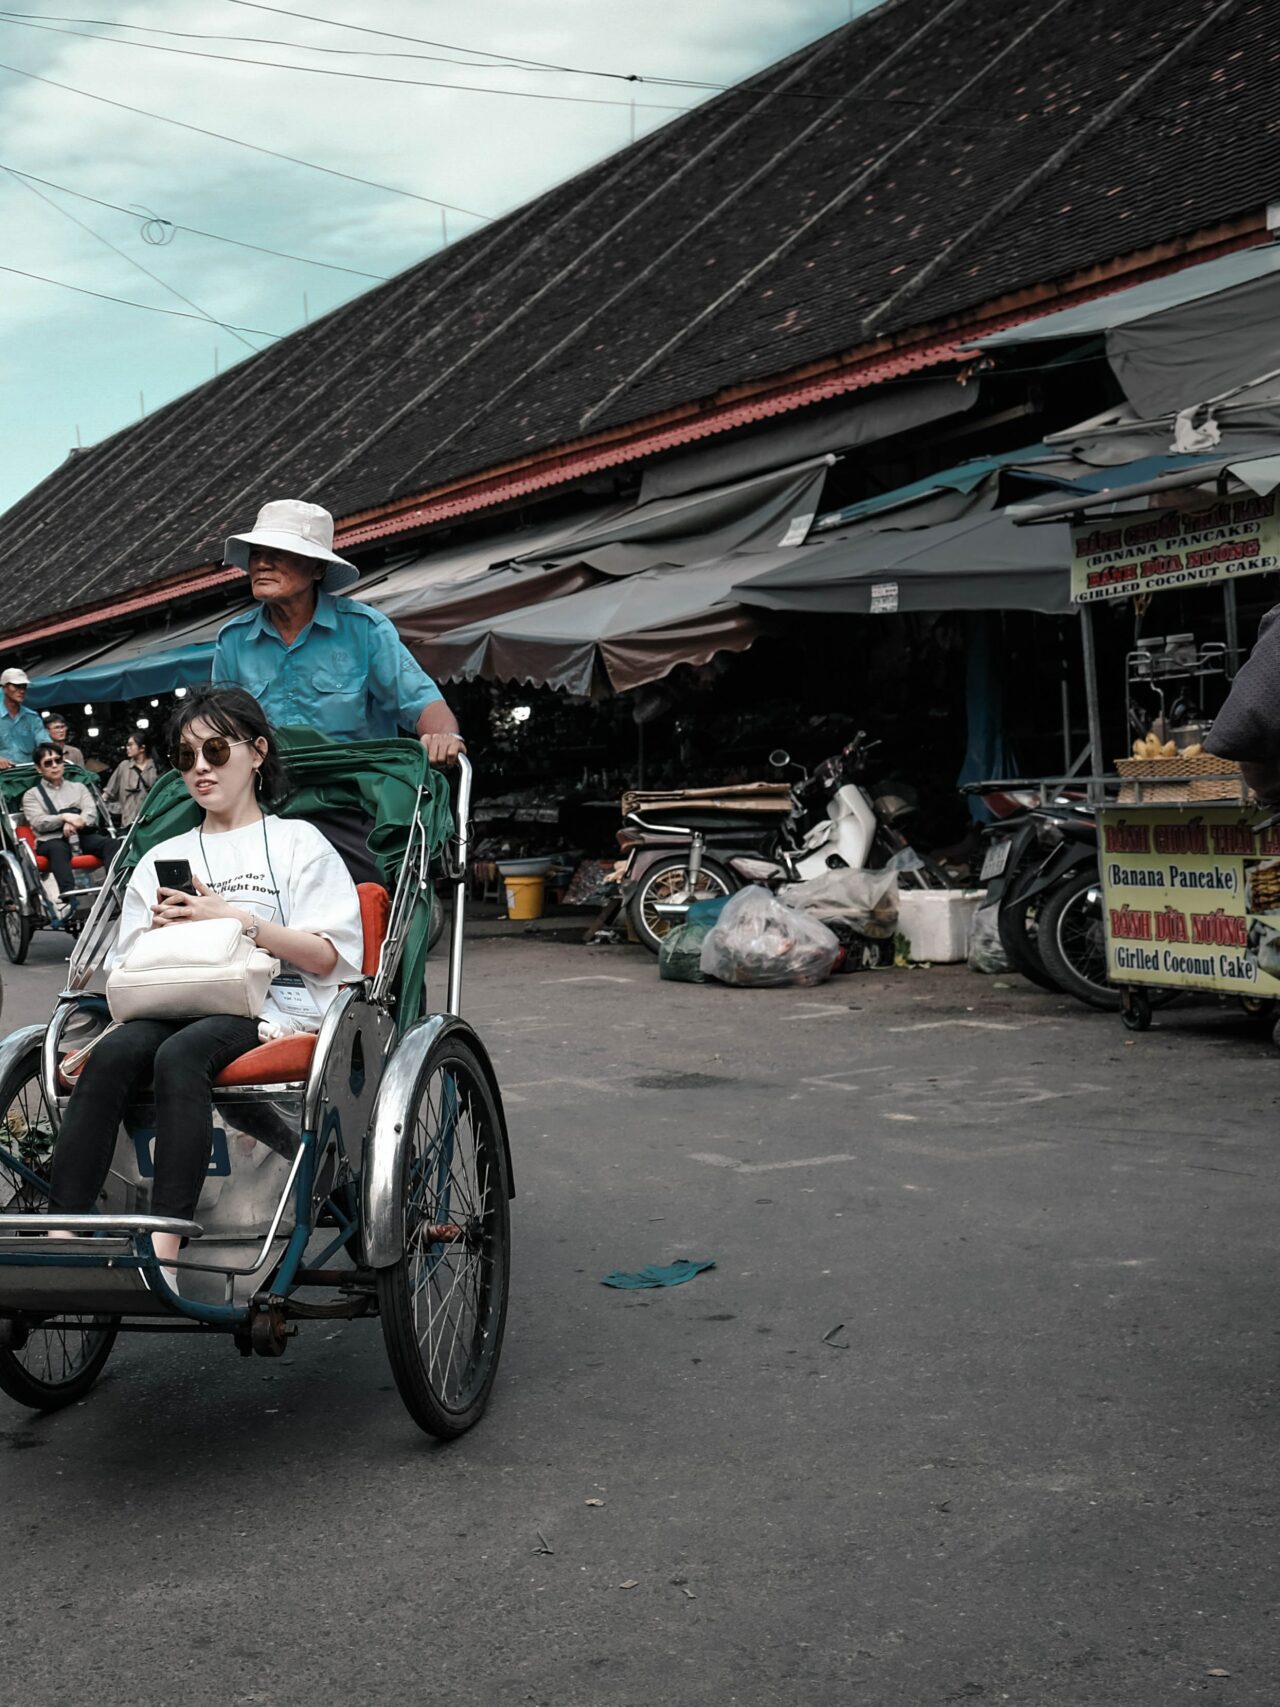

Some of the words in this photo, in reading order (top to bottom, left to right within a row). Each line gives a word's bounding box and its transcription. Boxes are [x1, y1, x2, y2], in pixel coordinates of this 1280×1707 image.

[1086, 543, 1158, 568] (BANANA
[1166, 522, 1261, 550] PANCAKE)
[1146, 566, 1219, 590] COCONUT
[1225, 555, 1278, 574] CAKE)
[245, 873, 265, 881] do?
[1108, 863, 1165, 889] (Banana
[1169, 865, 1238, 893] Pancake)
[1109, 903, 1153, 940] BÁNH
[1114, 946, 1159, 972] (Girlled
[1163, 950, 1215, 976] Coconut
[1219, 954, 1258, 983] Cake)
